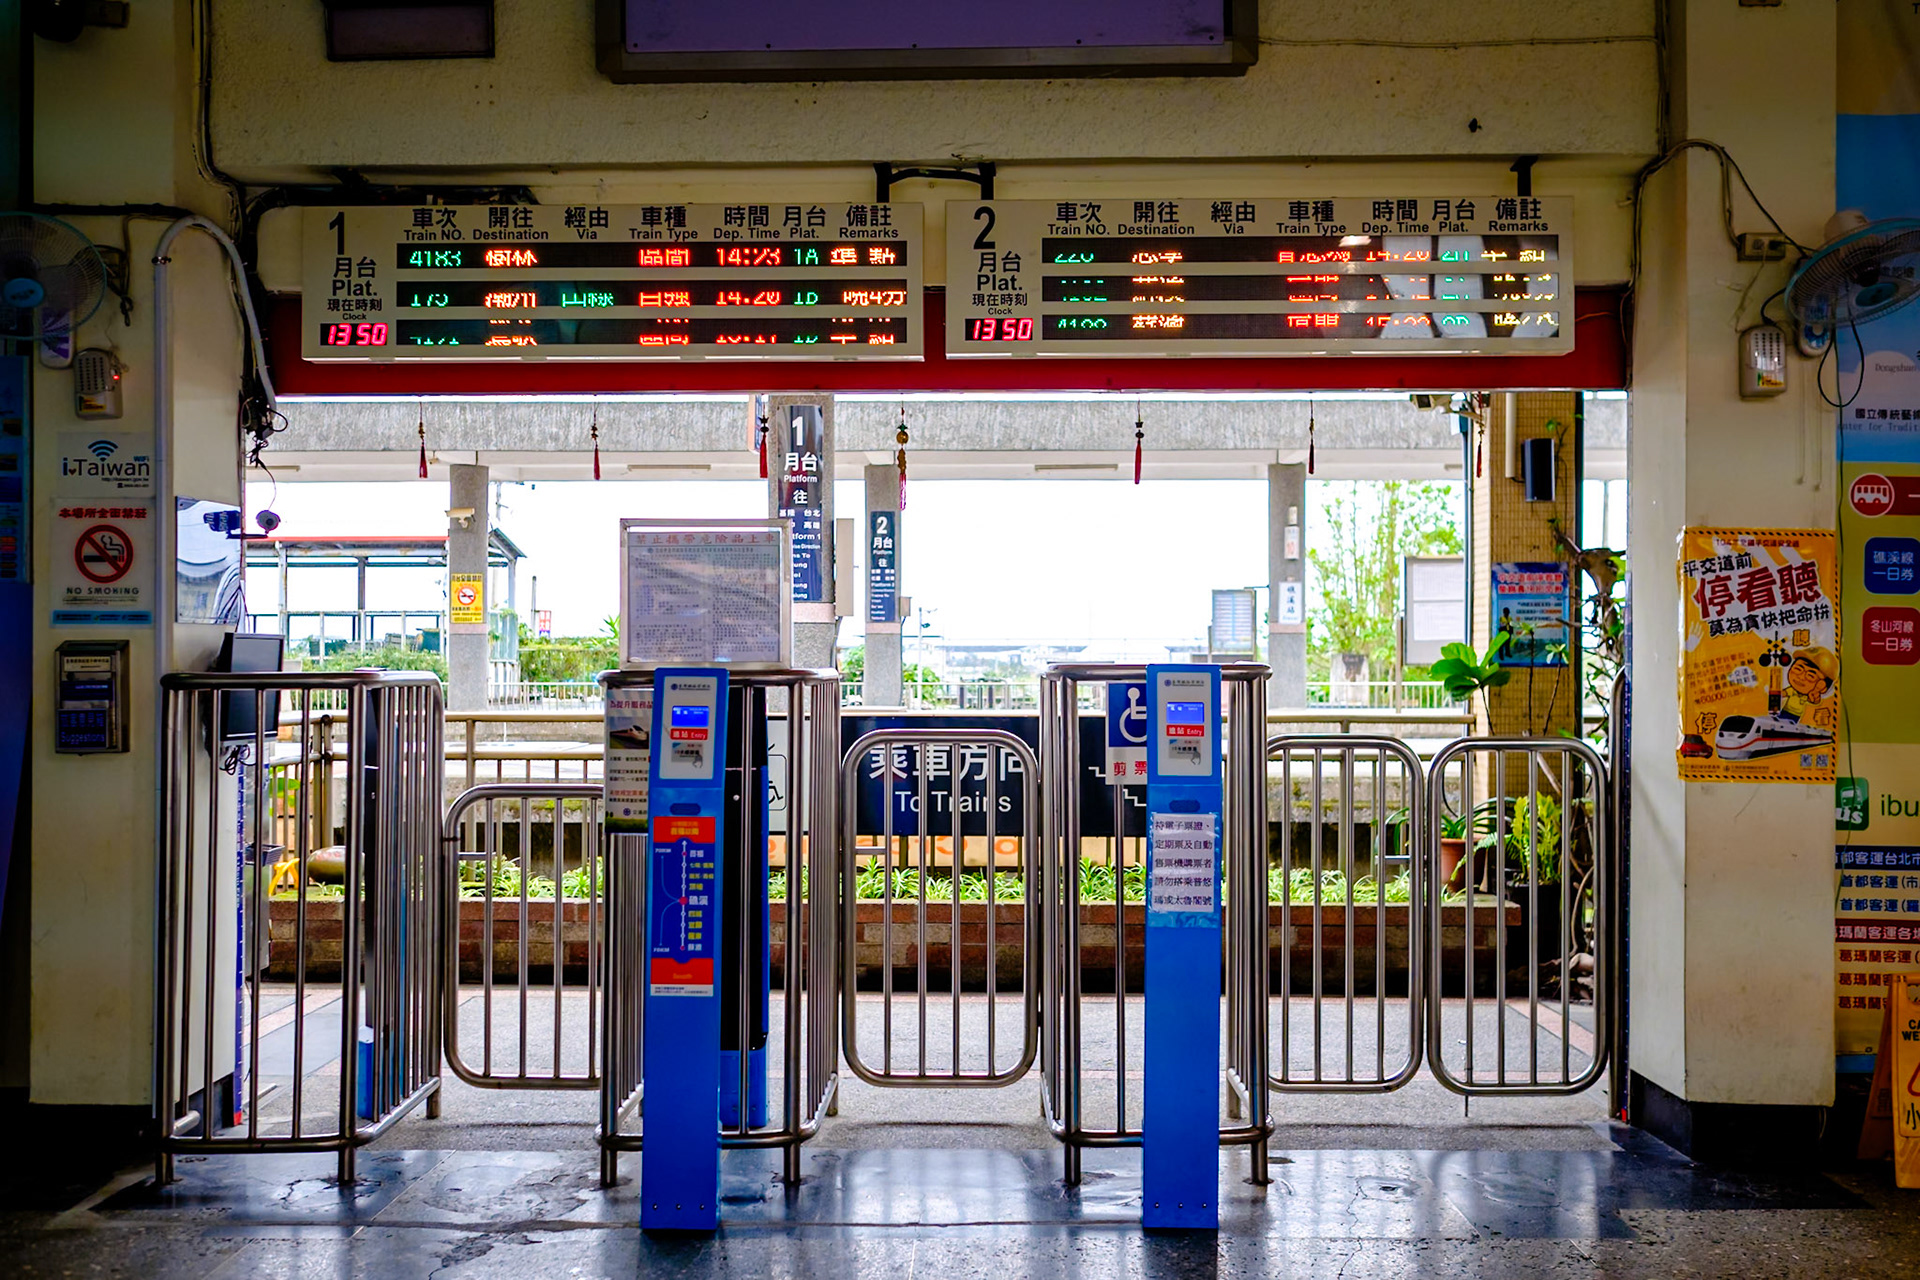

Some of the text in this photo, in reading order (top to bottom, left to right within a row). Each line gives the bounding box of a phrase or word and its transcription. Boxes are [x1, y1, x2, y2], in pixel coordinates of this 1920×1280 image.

[641, 206, 687, 228] 車種
[724, 206, 768, 227] 時間
[782, 206, 826, 227] 月台
[846, 205, 892, 227] 備註
[1056, 202, 1102, 223] 車次
[1133, 202, 1179, 223] 開往
[1211, 201, 1256, 223] 經由
[1288, 201, 1334, 222] 車種
[1372, 200, 1418, 221] 時間
[1432, 200, 1476, 221] 月台
[1495, 199, 1542, 221] 備註
[412, 208, 457, 229] 車次
[489, 207, 533, 228] 開往
[564, 207, 609, 229] 經由
[329, 211, 344, 254] 1
[790, 228, 820, 239] Plat.
[839, 227, 898, 238] Remarks
[973, 206, 996, 250] 2
[1048, 224, 1110, 235] Train NO.
[1118, 223, 1195, 235] Destination
[1223, 223, 1244, 234] Via
[1276, 222, 1346, 236] Train Type
[1362, 222, 1429, 235] Dep. Time
[1439, 221, 1469, 233] Plat.
[1489, 221, 1548, 232] Remarks
[404, 229, 465, 241] Train NO.
[472, 228, 549, 240] Destination
[576, 228, 597, 240] Via
[629, 228, 698, 241] Train Type
[714, 228, 780, 241] Dep. Time
[333, 257, 377, 278] 月台
[978, 251, 1022, 273] 月台
[332, 279, 378, 296] Plat.
[977, 274, 1022, 291] Plat.
[327, 298, 382, 311] 現在時刻
[972, 293, 1028, 306] 現在時刻
[342, 312, 367, 321] Clock
[988, 307, 1013, 316] Clock
[792, 416, 804, 445] 1
[784, 453, 818, 472] 月台
[784, 474, 818, 483] Platform
[793, 490, 808, 505] 往
[804, 509, 820, 517] 台北
[876, 516, 888, 534] 2
[873, 537, 893, 549] 月台
[878, 558, 888, 567] 往
[1873, 551, 1914, 565] 礁溪線
[1872, 567, 1914, 581] 一日券
[66, 587, 139, 595] NO SMOKING
[1693, 561, 1821, 619] 停看聽
[1870, 620, 1914, 633] 冬山河線
[1870, 637, 1913, 652] 一日券
[1114, 761, 1147, 776] 剪票
[1155, 839, 1212, 850] 定期票及自動
[1155, 858, 1212, 868] 售票機購票者
[1836, 851, 1920, 866] 都客運台北市
[1154, 895, 1212, 906] 瑪或太魯閣號
